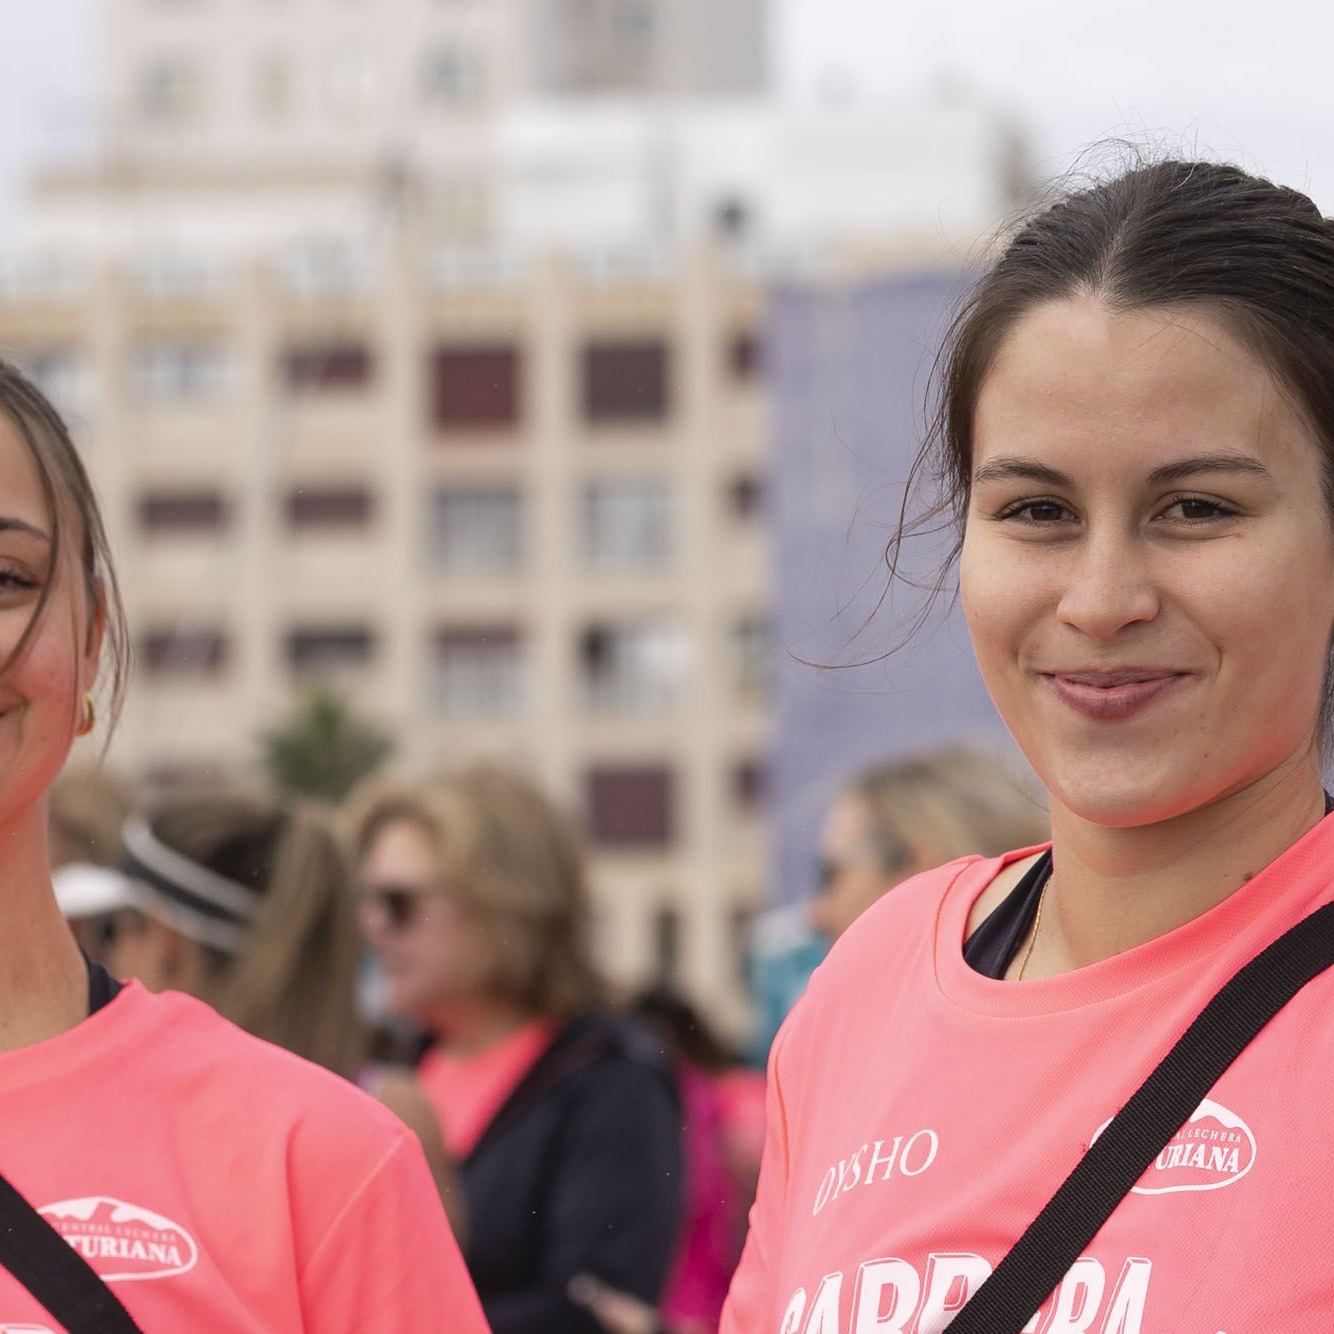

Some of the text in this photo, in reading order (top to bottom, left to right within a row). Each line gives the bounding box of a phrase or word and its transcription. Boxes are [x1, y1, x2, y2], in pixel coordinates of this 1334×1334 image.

[1189, 1128, 1243, 1143] LECHERA
[812, 1129, 939, 1217] OYSHO
[1155, 1143, 1240, 1173] URIANA
[63, 1234, 184, 1268] TURIANA
